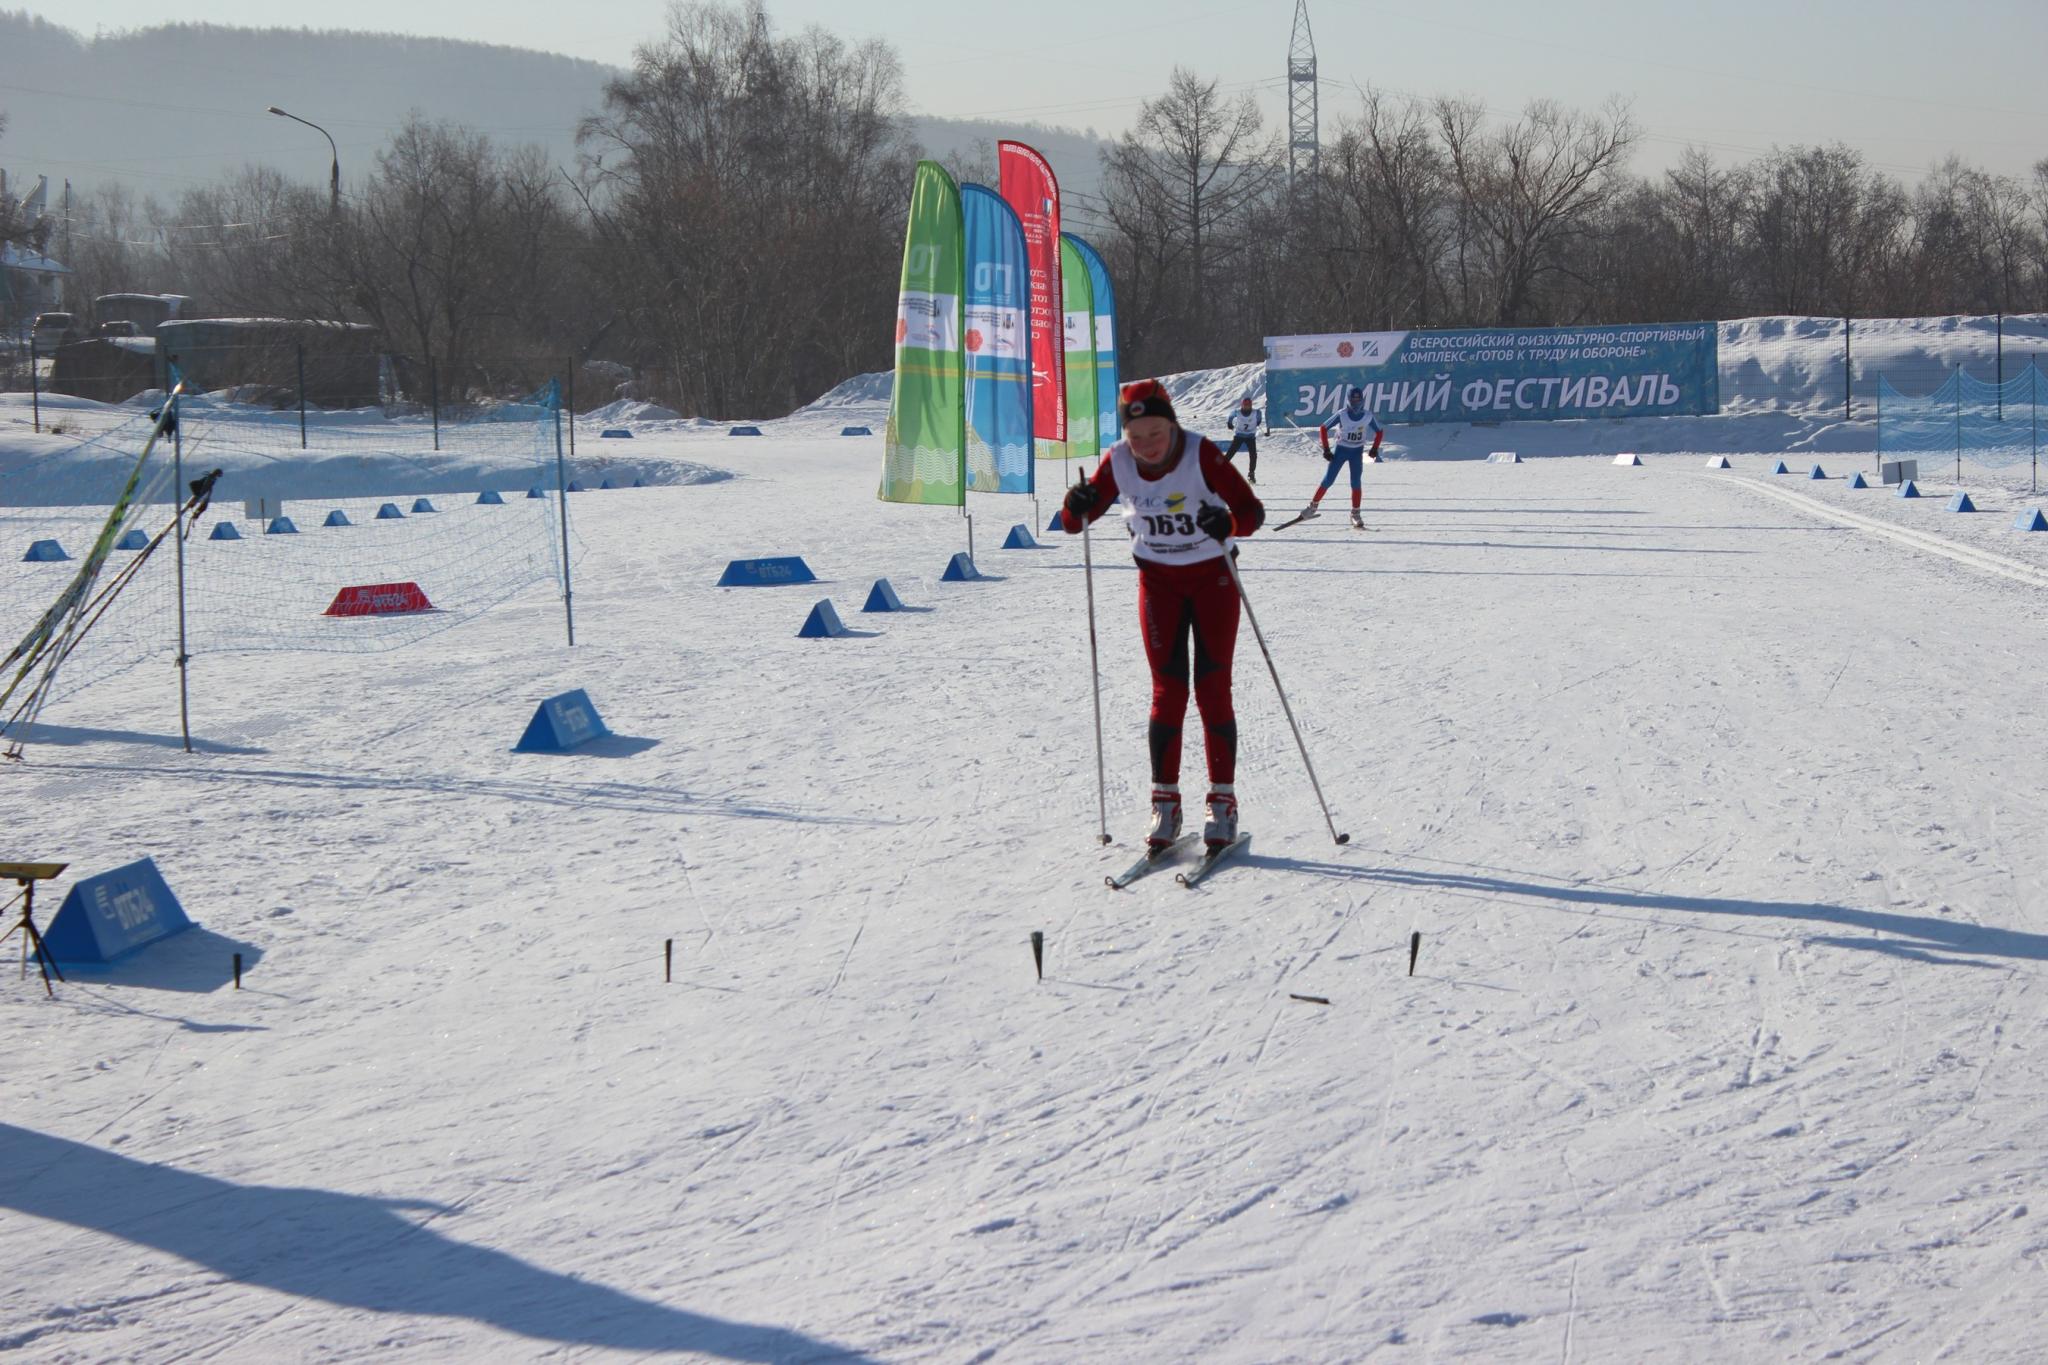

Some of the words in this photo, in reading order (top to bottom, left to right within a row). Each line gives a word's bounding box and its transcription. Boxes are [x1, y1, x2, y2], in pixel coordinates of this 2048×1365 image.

[1410, 334, 1518, 349] ВСЕРОССИЙСКИЙ
[1517, 327, 1706, 346] ФИЗКУЛЬТУРНО-СПОРТИВНЫЙ
[1400, 351, 1467, 363] КОМПЛЕКС
[1469, 349, 1514, 361] «ГОТОВ
[1517, 349, 1526, 360] К
[1529, 348, 1567, 361] ТРУДУ
[1570, 348, 1579, 359] И
[1582, 346, 1646, 359] ОБОРОНЕ»
[1294, 373, 1452, 416] ЗИМНИЙ
[1461, 374, 1680, 411] ФЕСТИВАЛЬ
[1142, 513, 1195, 536] 163
